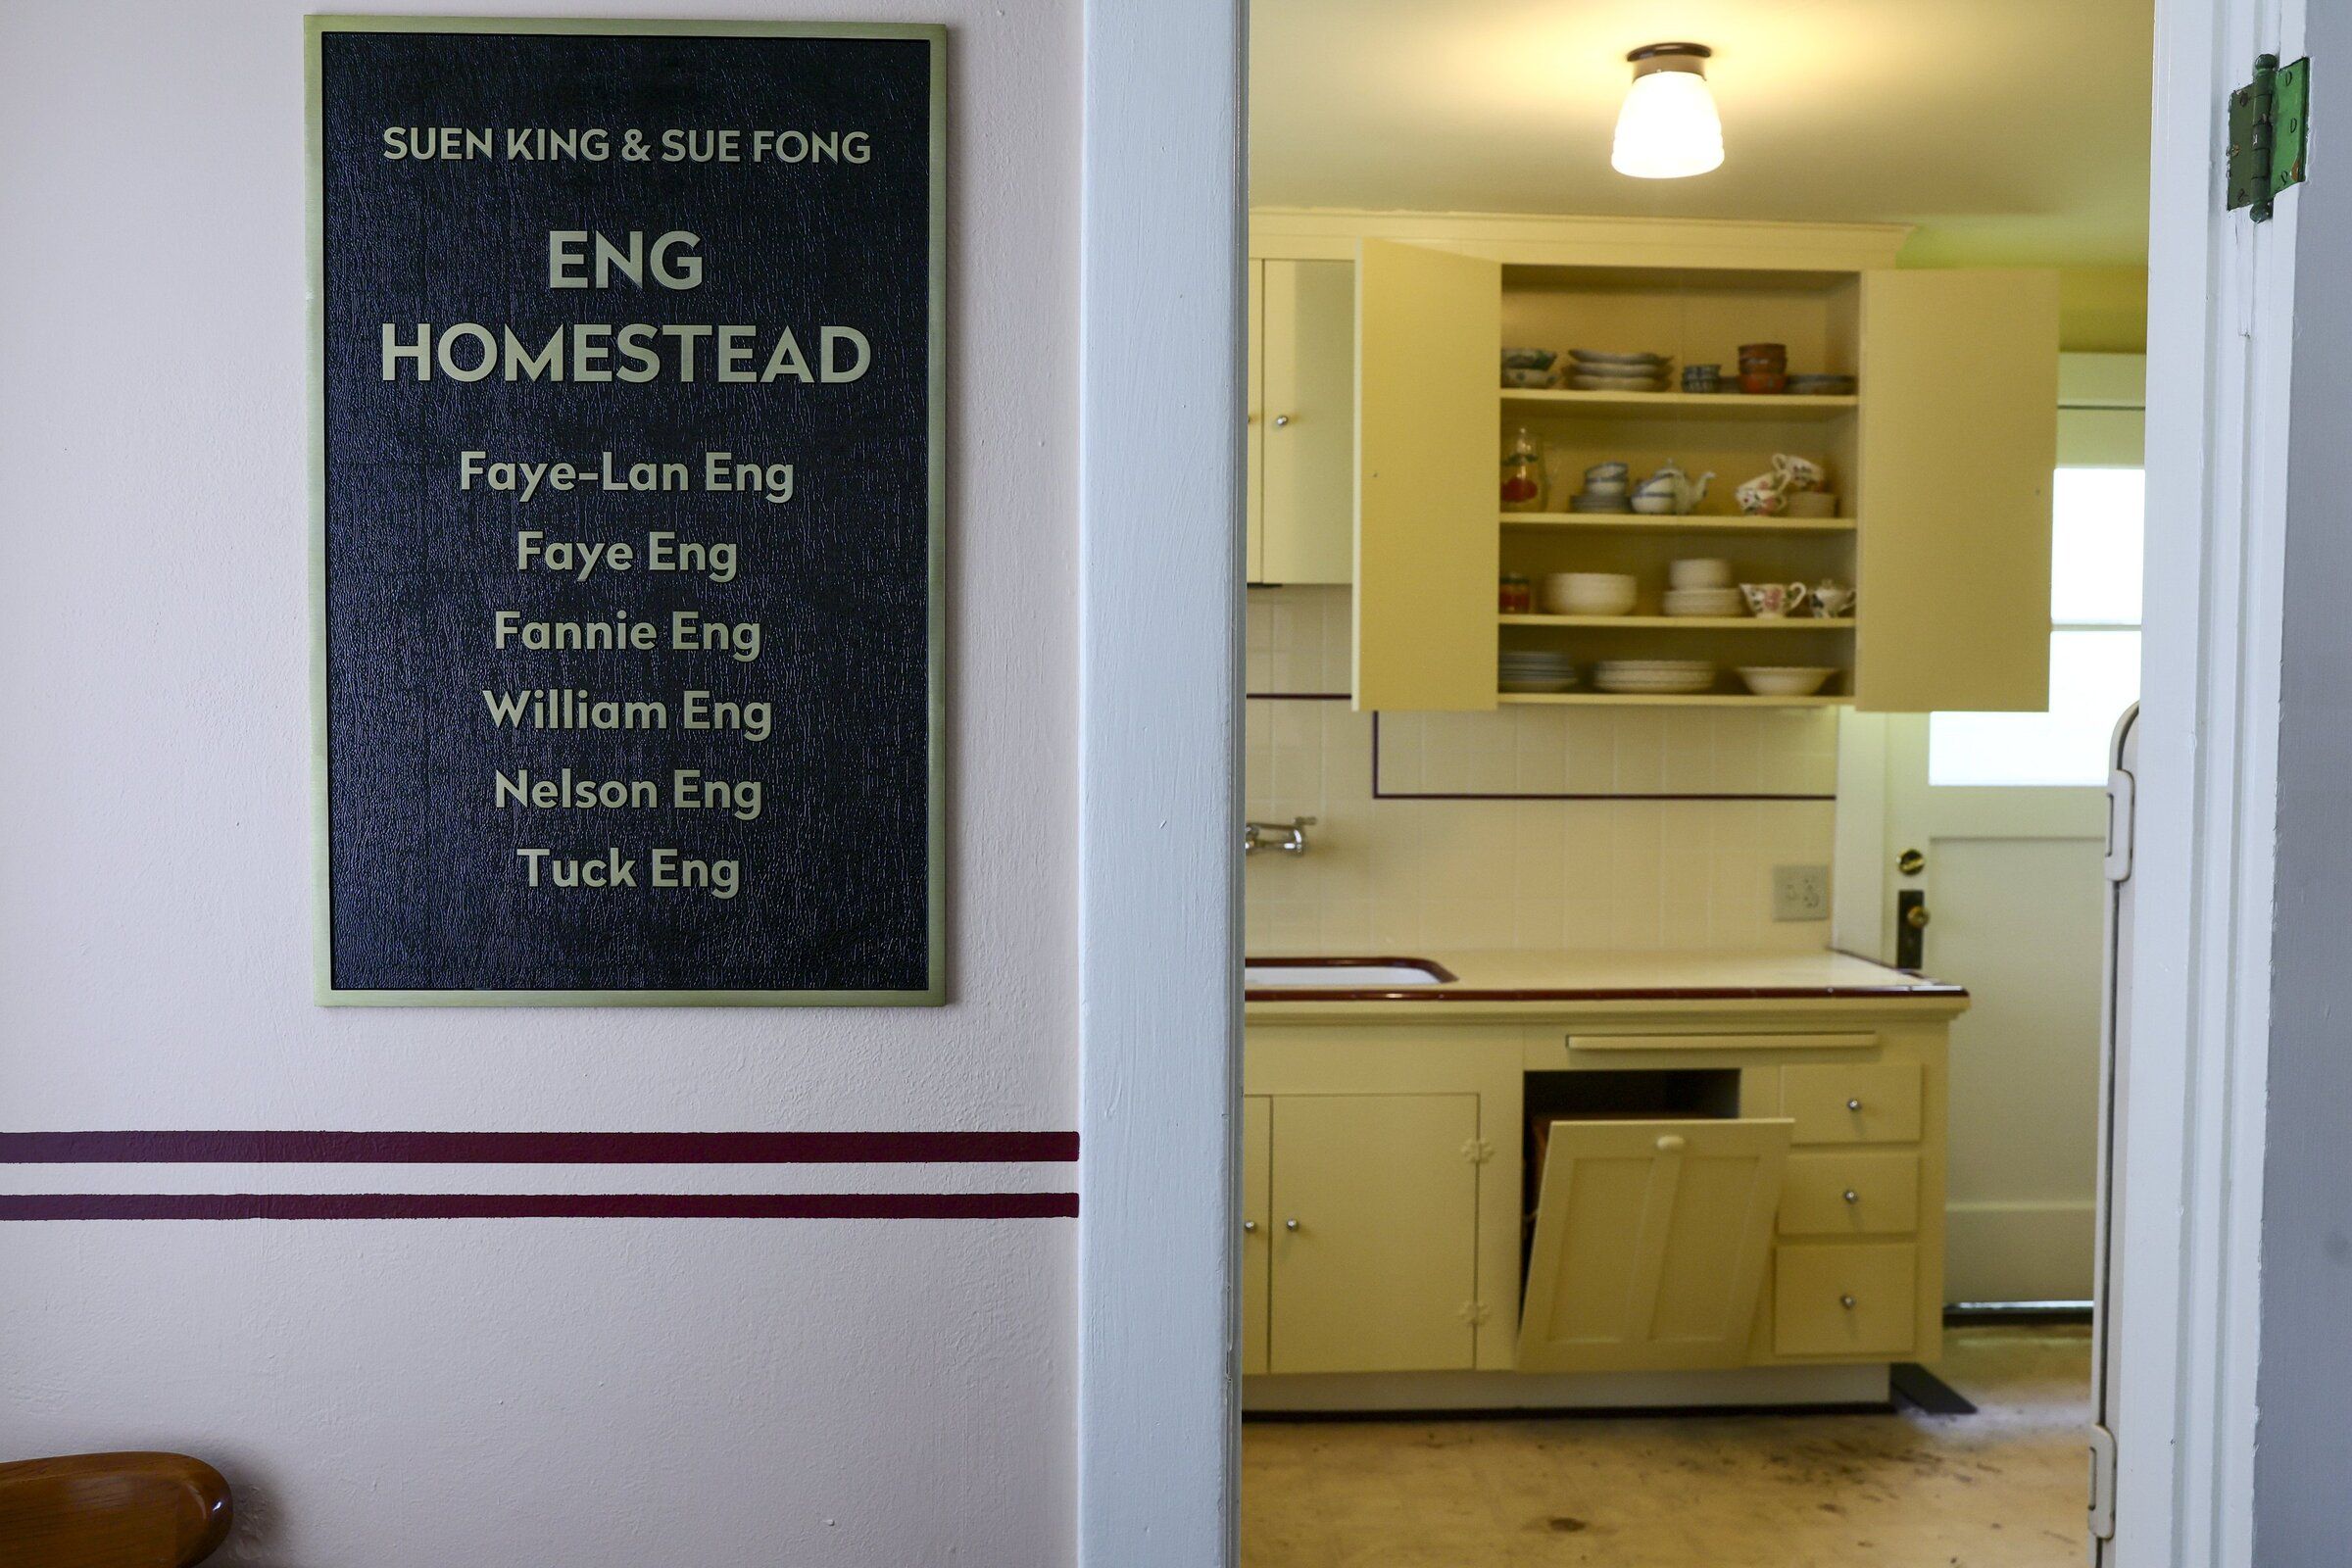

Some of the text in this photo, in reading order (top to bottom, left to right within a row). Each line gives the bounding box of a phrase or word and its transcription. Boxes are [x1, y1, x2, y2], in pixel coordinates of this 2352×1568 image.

[383, 126, 869, 164] SUEN KING & SUE FONG
[550, 230, 703, 290] ENG
[382, 322, 870, 383] HOMESTEAD
[461, 451, 793, 504] Faye-Lan Eng
[517, 530, 736, 582] Faye Eng
[496, 610, 760, 662] Fannie Eng
[482, 689, 770, 742] William Eng
[495, 769, 760, 820] Nelson Eng
[516, 847, 739, 899] Tuck Eng
